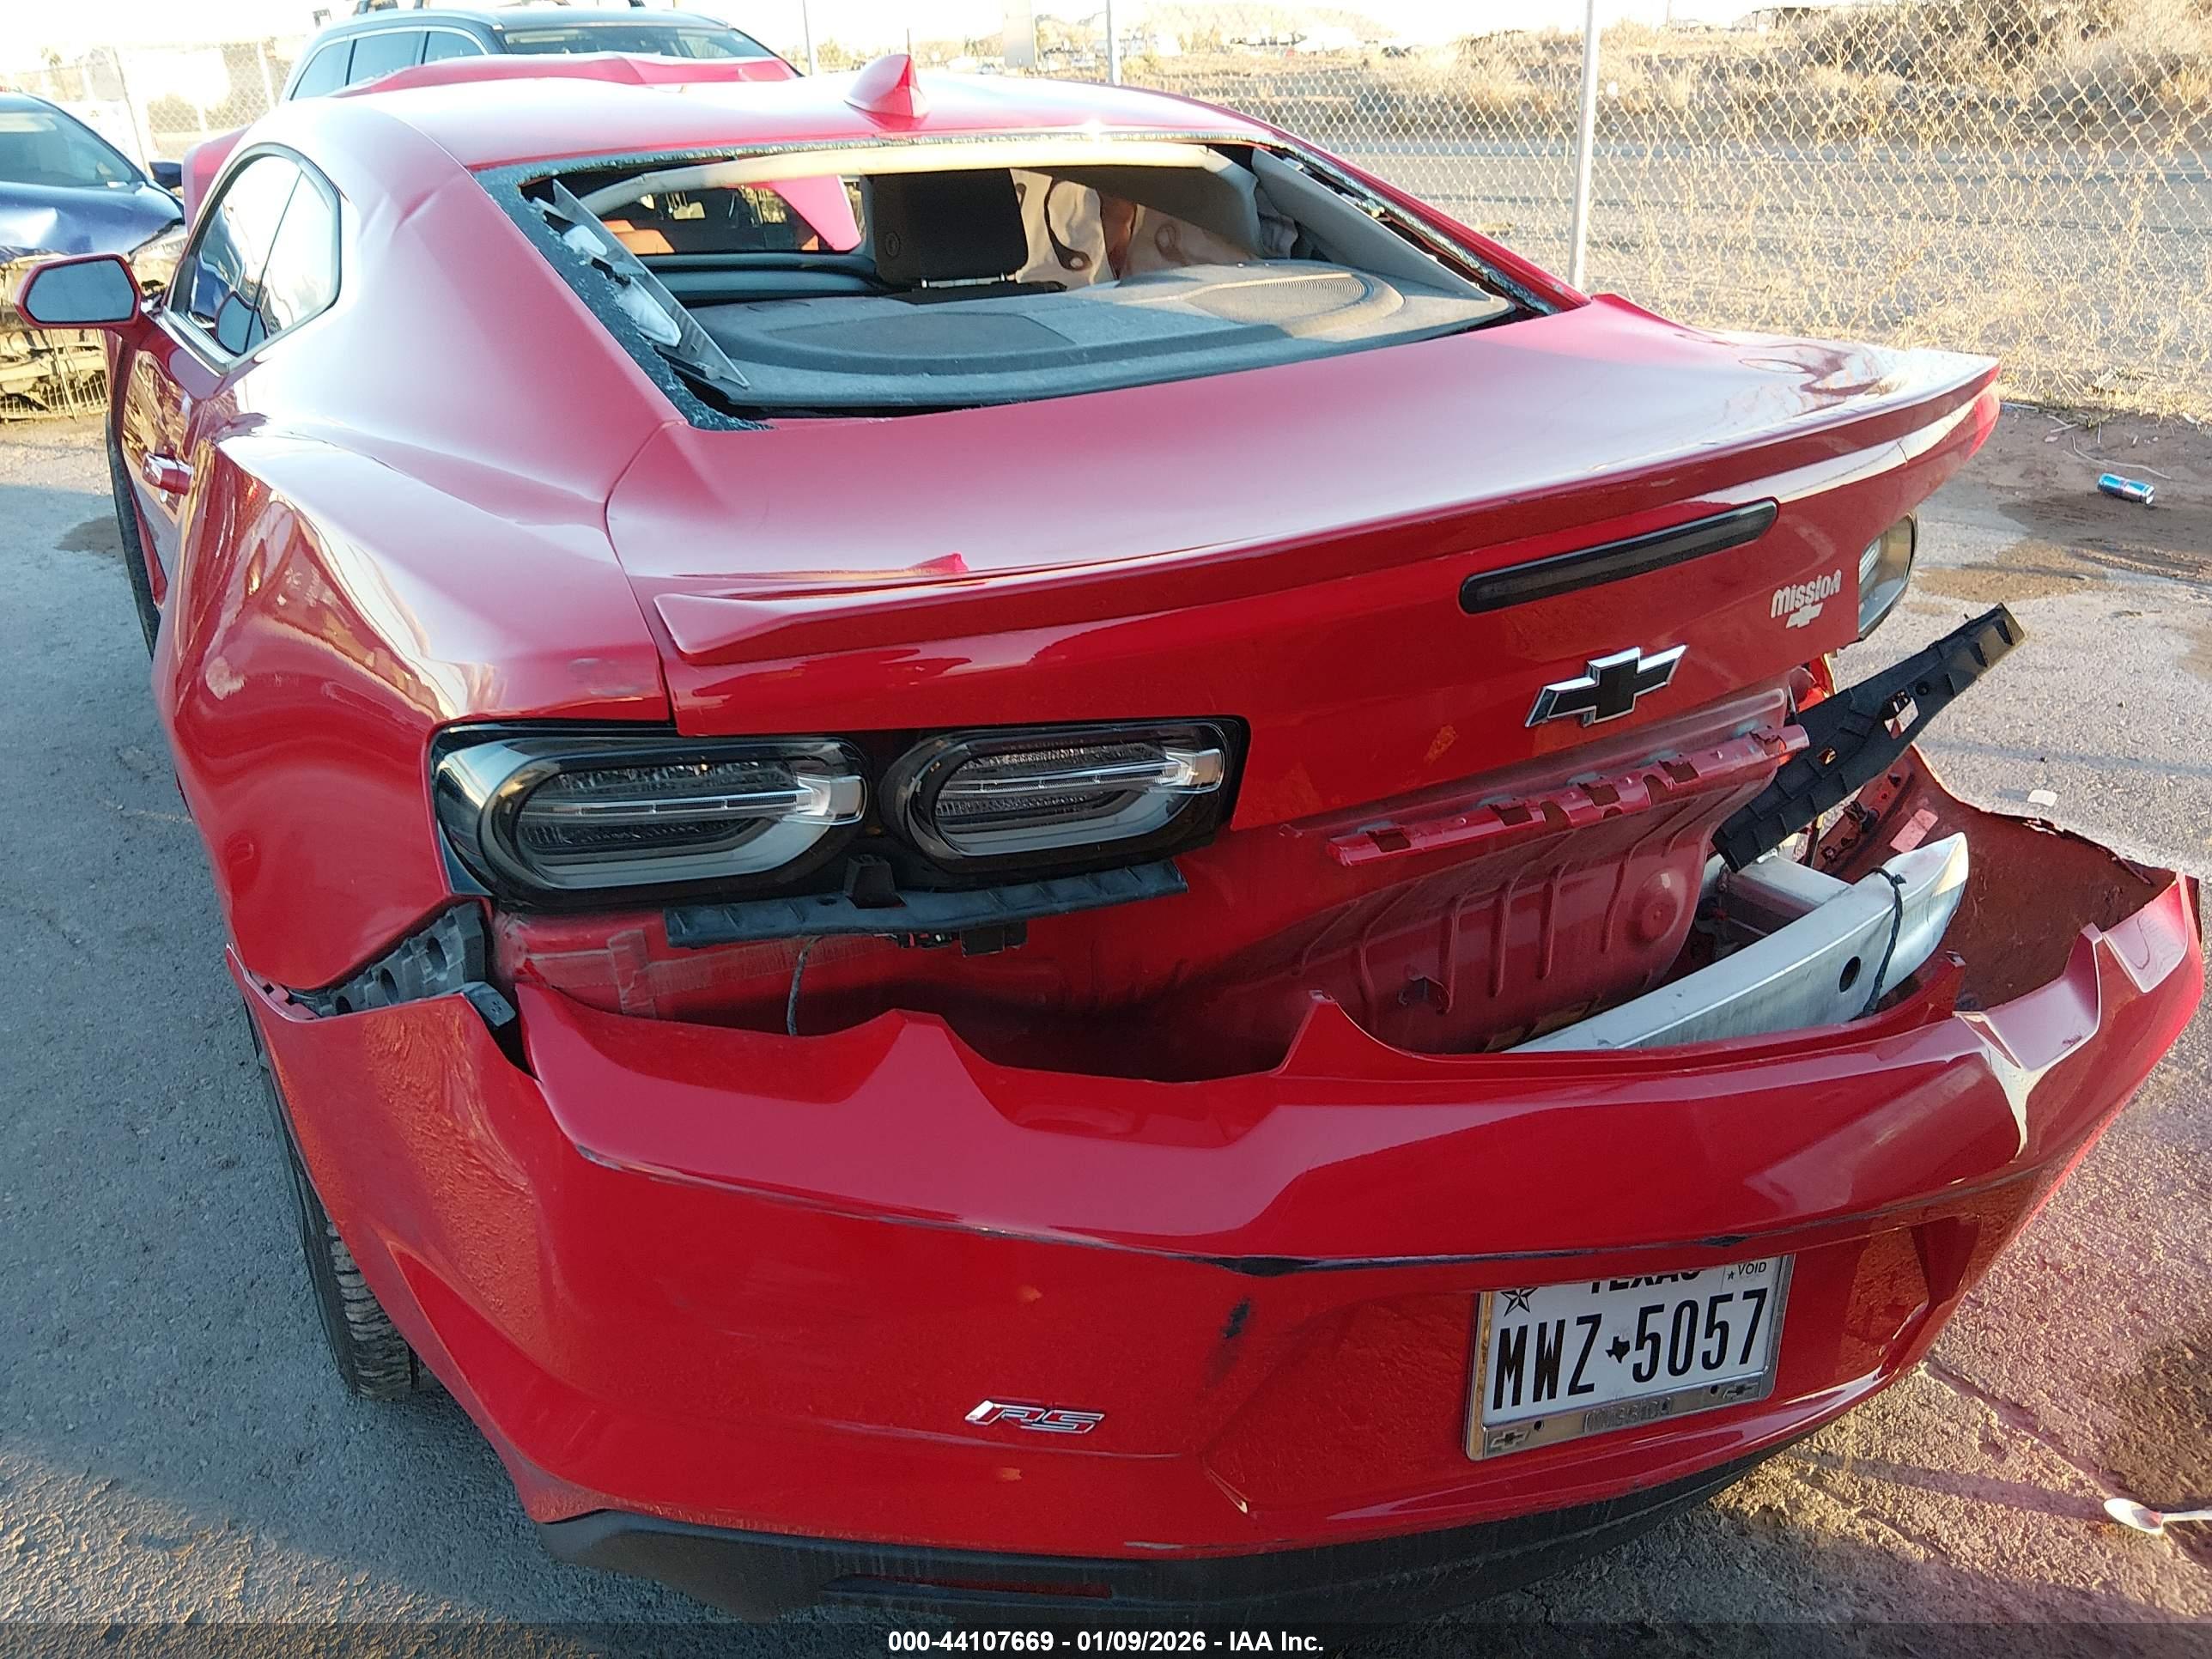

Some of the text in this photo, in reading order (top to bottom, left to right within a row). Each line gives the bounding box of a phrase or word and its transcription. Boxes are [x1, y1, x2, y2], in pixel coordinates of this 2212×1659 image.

[1738, 1261, 1767, 1275] VOID
[1492, 1288, 1768, 1410] MWZ 5057
[964, 1400, 1105, 1434] RS
